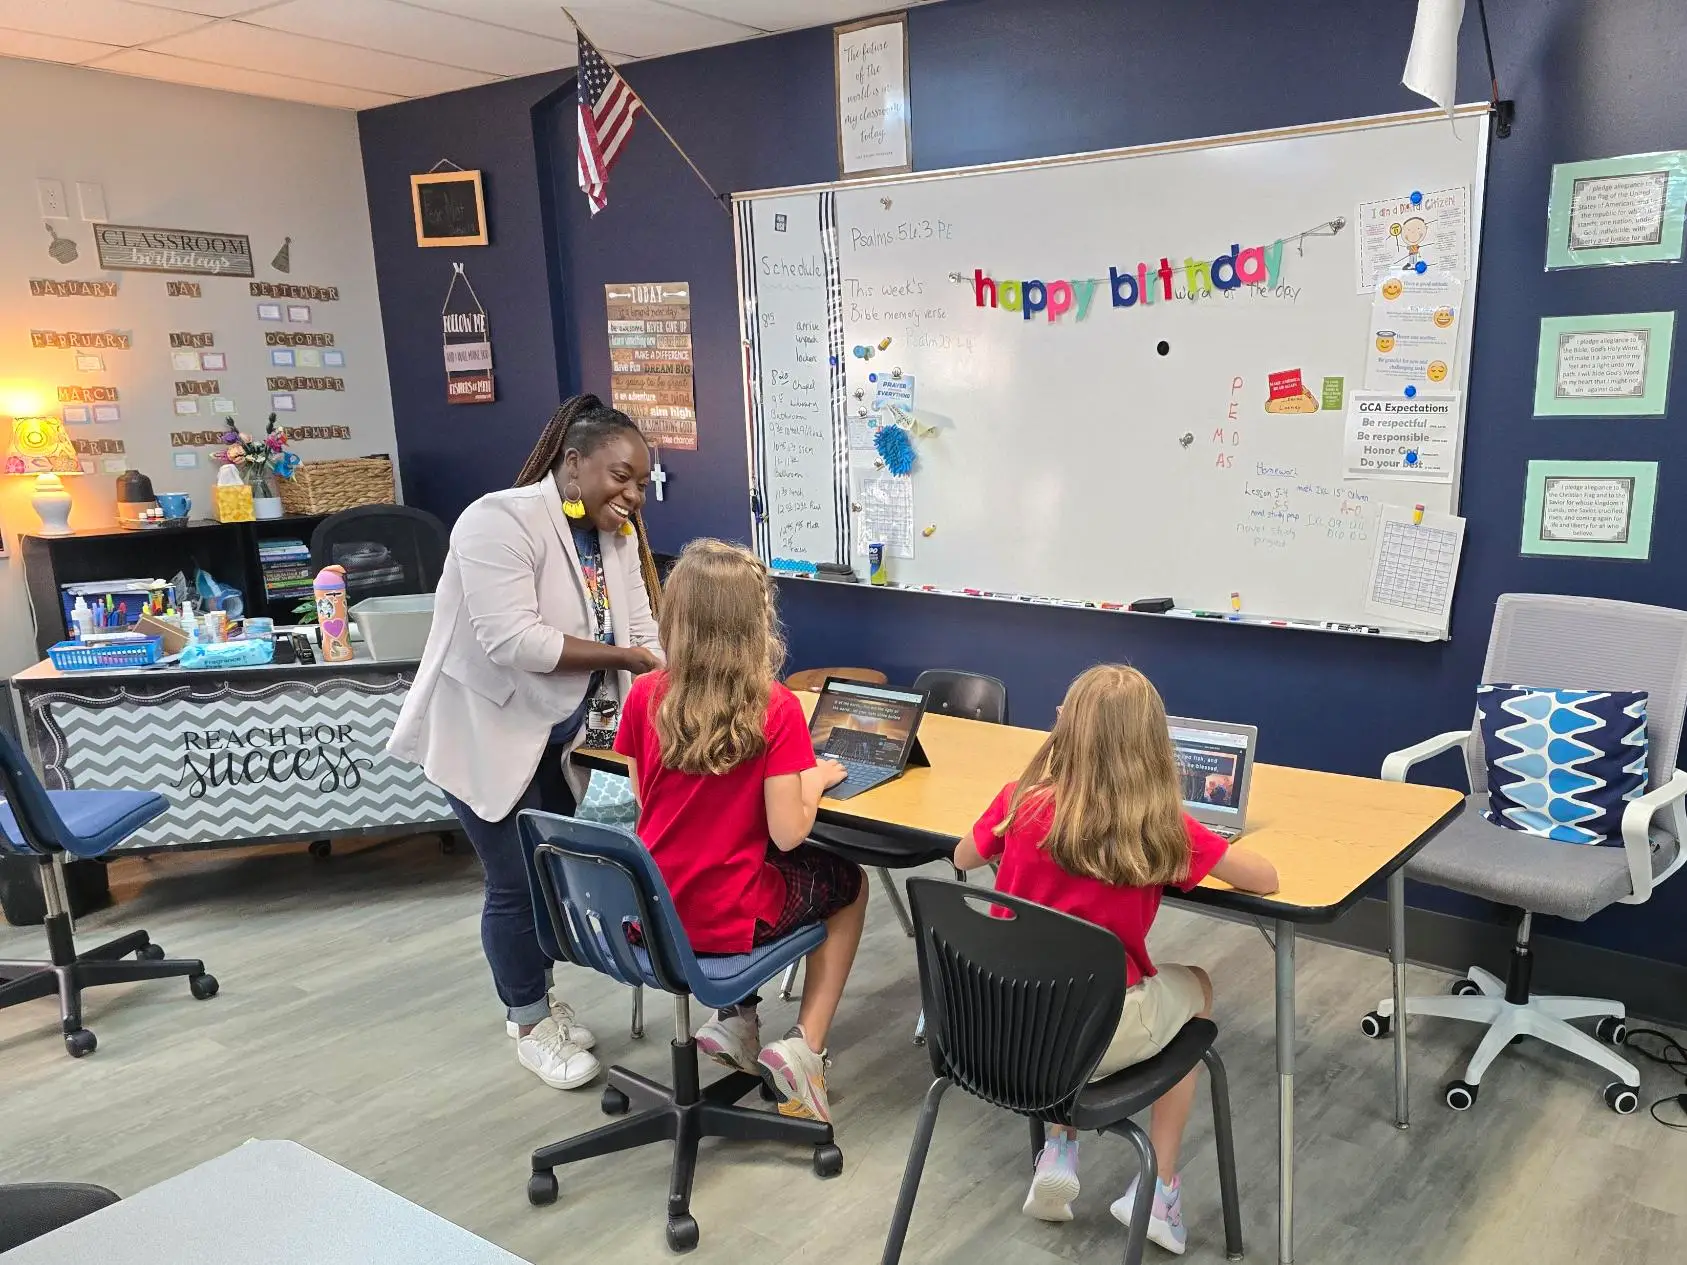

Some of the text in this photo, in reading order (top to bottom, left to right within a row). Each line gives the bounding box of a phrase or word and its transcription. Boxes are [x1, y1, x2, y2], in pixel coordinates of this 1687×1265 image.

[843, 40, 888, 63] The future
[855, 63, 880, 84] of the
[847, 84, 870, 103] world
[844, 114, 858, 130] my
[101, 229, 249, 254] CLASSROOM
[851, 227, 894, 251] Psalms
[130, 248, 230, 273] birthdays
[761, 255, 821, 276] Schedule
[31, 280, 116, 296] JANUARY
[167, 282, 201, 297] MAY
[250, 283, 339, 300] SEPTEMBER
[630, 285, 662, 304] TODAY
[844, 276, 923, 298] This week's
[1275, 277, 1301, 304] day
[974, 268, 1097, 323] happy
[443, 313, 486, 333] FOLLOW ME
[884, 309, 921, 327] memory
[923, 307, 947, 319] verse
[646, 320, 688, 333] NEVER GIVE UP
[170, 333, 213, 347] JUNE
[266, 332, 334, 346] OCTOBER
[634, 350, 650, 360] MAKE
[650, 350, 655, 359] A
[655, 350, 689, 360] DIFFERENCE
[644, 363, 691, 374] DREAM BIG
[176, 380, 219, 395] JULY
[267, 377, 345, 391] NOVEMBER
[882, 381, 907, 389] PRAYER
[1231, 376, 1243, 396] P
[58, 387, 117, 402] MARCH
[628, 391, 656, 401] adventure
[877, 390, 910, 399] EVERYTHING
[650, 405, 692, 419] aim high
[1228, 402, 1238, 420] E
[1359, 402, 1449, 413] GCA Expectations
[1362, 418, 1428, 429] Be respectful
[171, 432, 225, 446] AUGUS
[285, 426, 351, 440] ECEMBER
[1357, 431, 1370, 440] Be
[1372, 433, 1430, 442] responsible
[76, 440, 125, 454] PRIL
[1363, 445, 1395, 454] Honor
[1360, 458, 1374, 466] Do
[1376, 460, 1400, 468] your
[204, 656, 241, 665] Fragrance
[181, 724, 357, 751] REACH FOR
[170, 746, 374, 799] success
